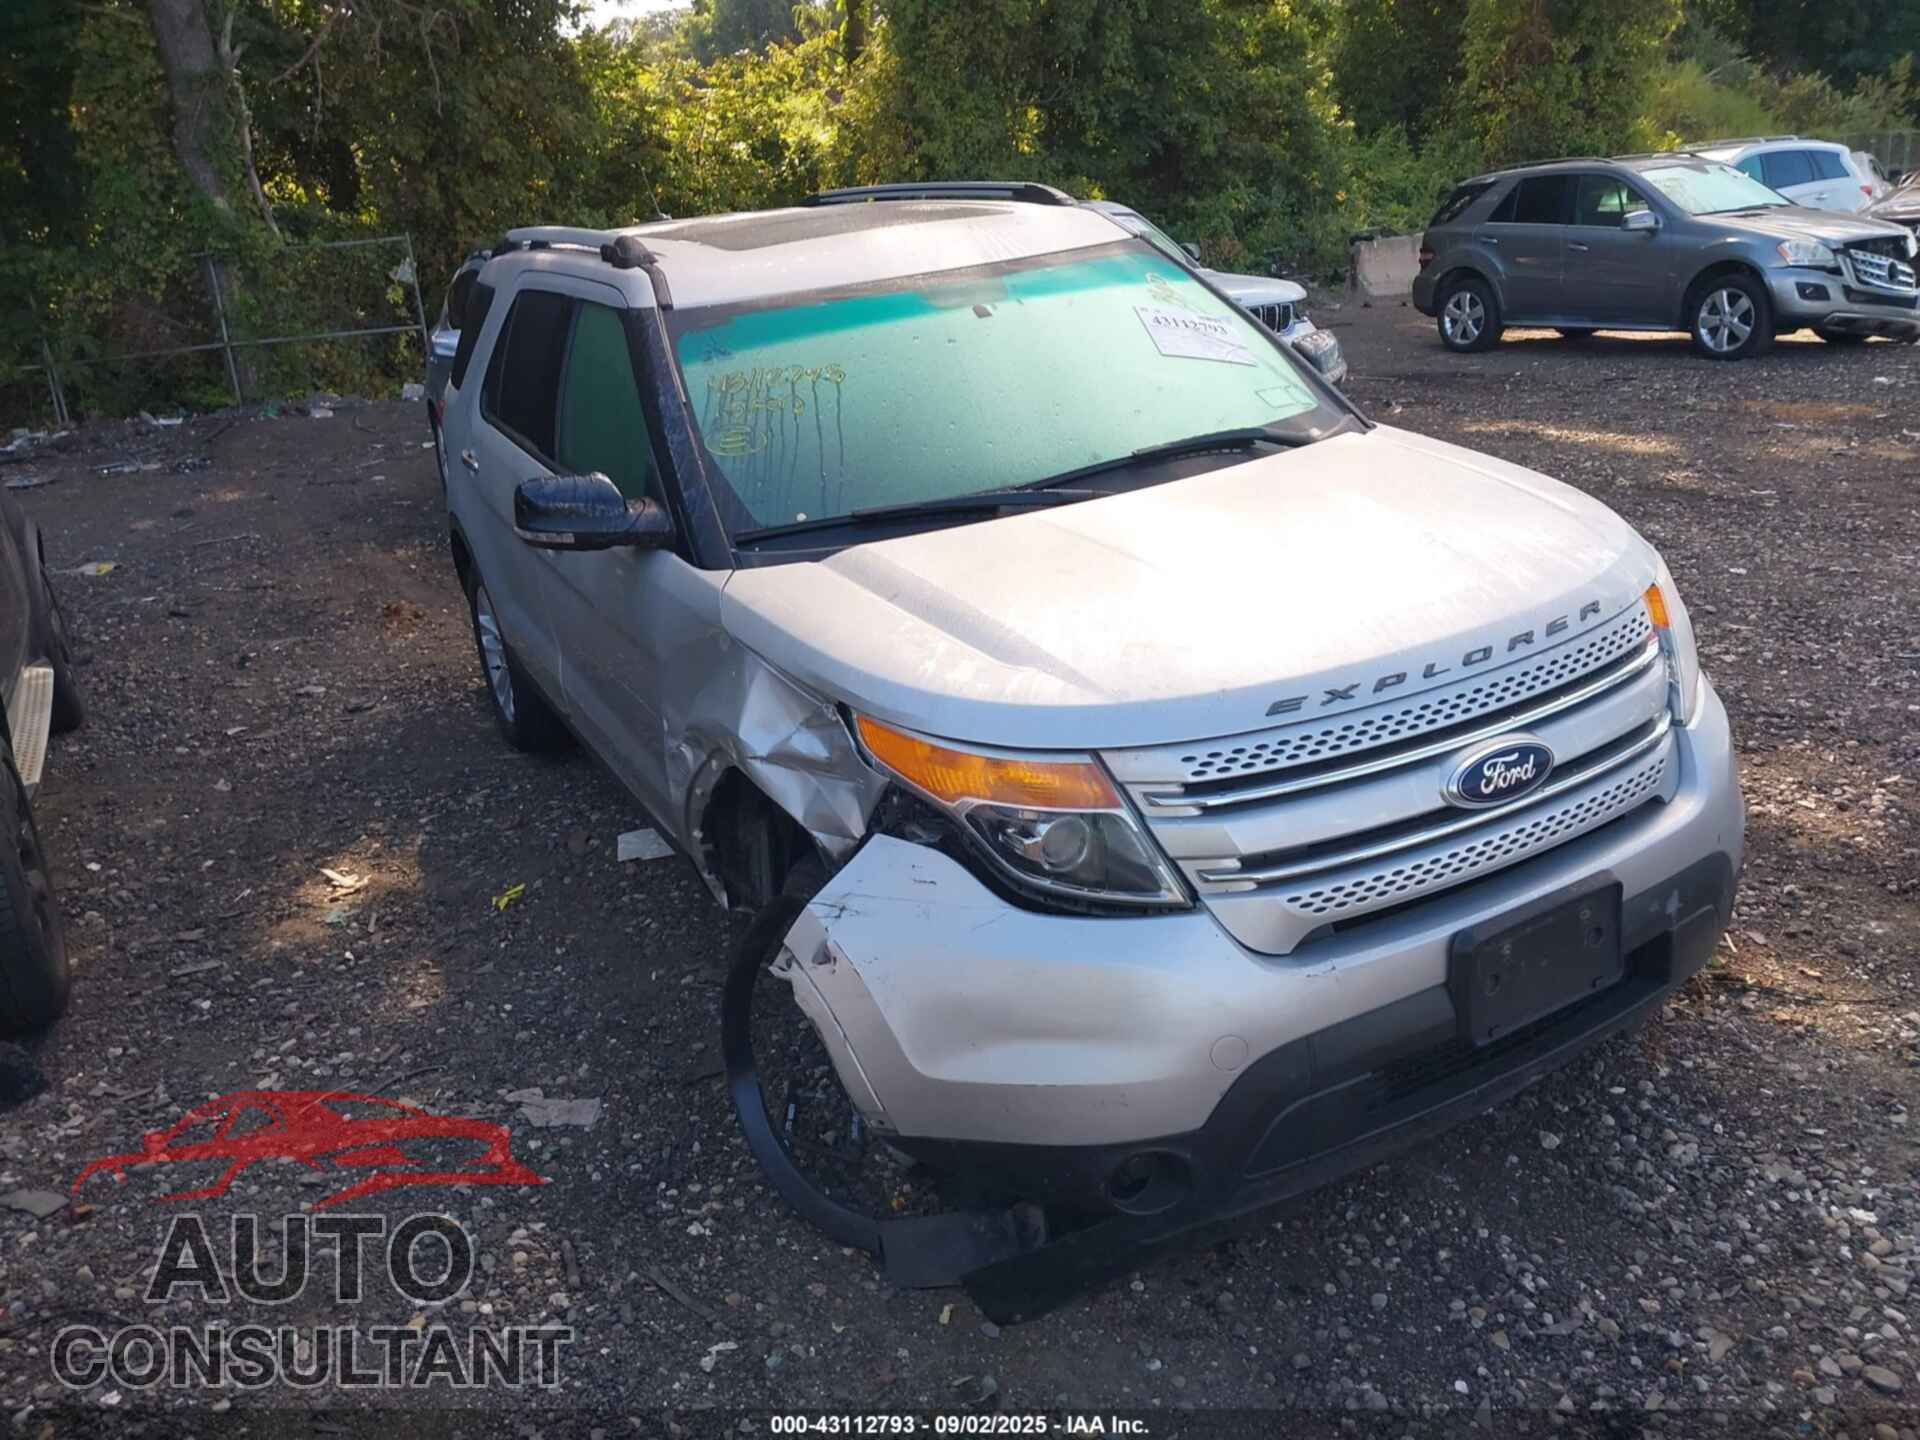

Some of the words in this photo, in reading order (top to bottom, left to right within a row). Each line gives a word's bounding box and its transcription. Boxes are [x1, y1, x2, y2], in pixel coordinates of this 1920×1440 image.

[1151, 315, 1229, 336] 43112793
[1265, 599, 1601, 717] EXPLORER
[1480, 751, 1536, 795] Ford
